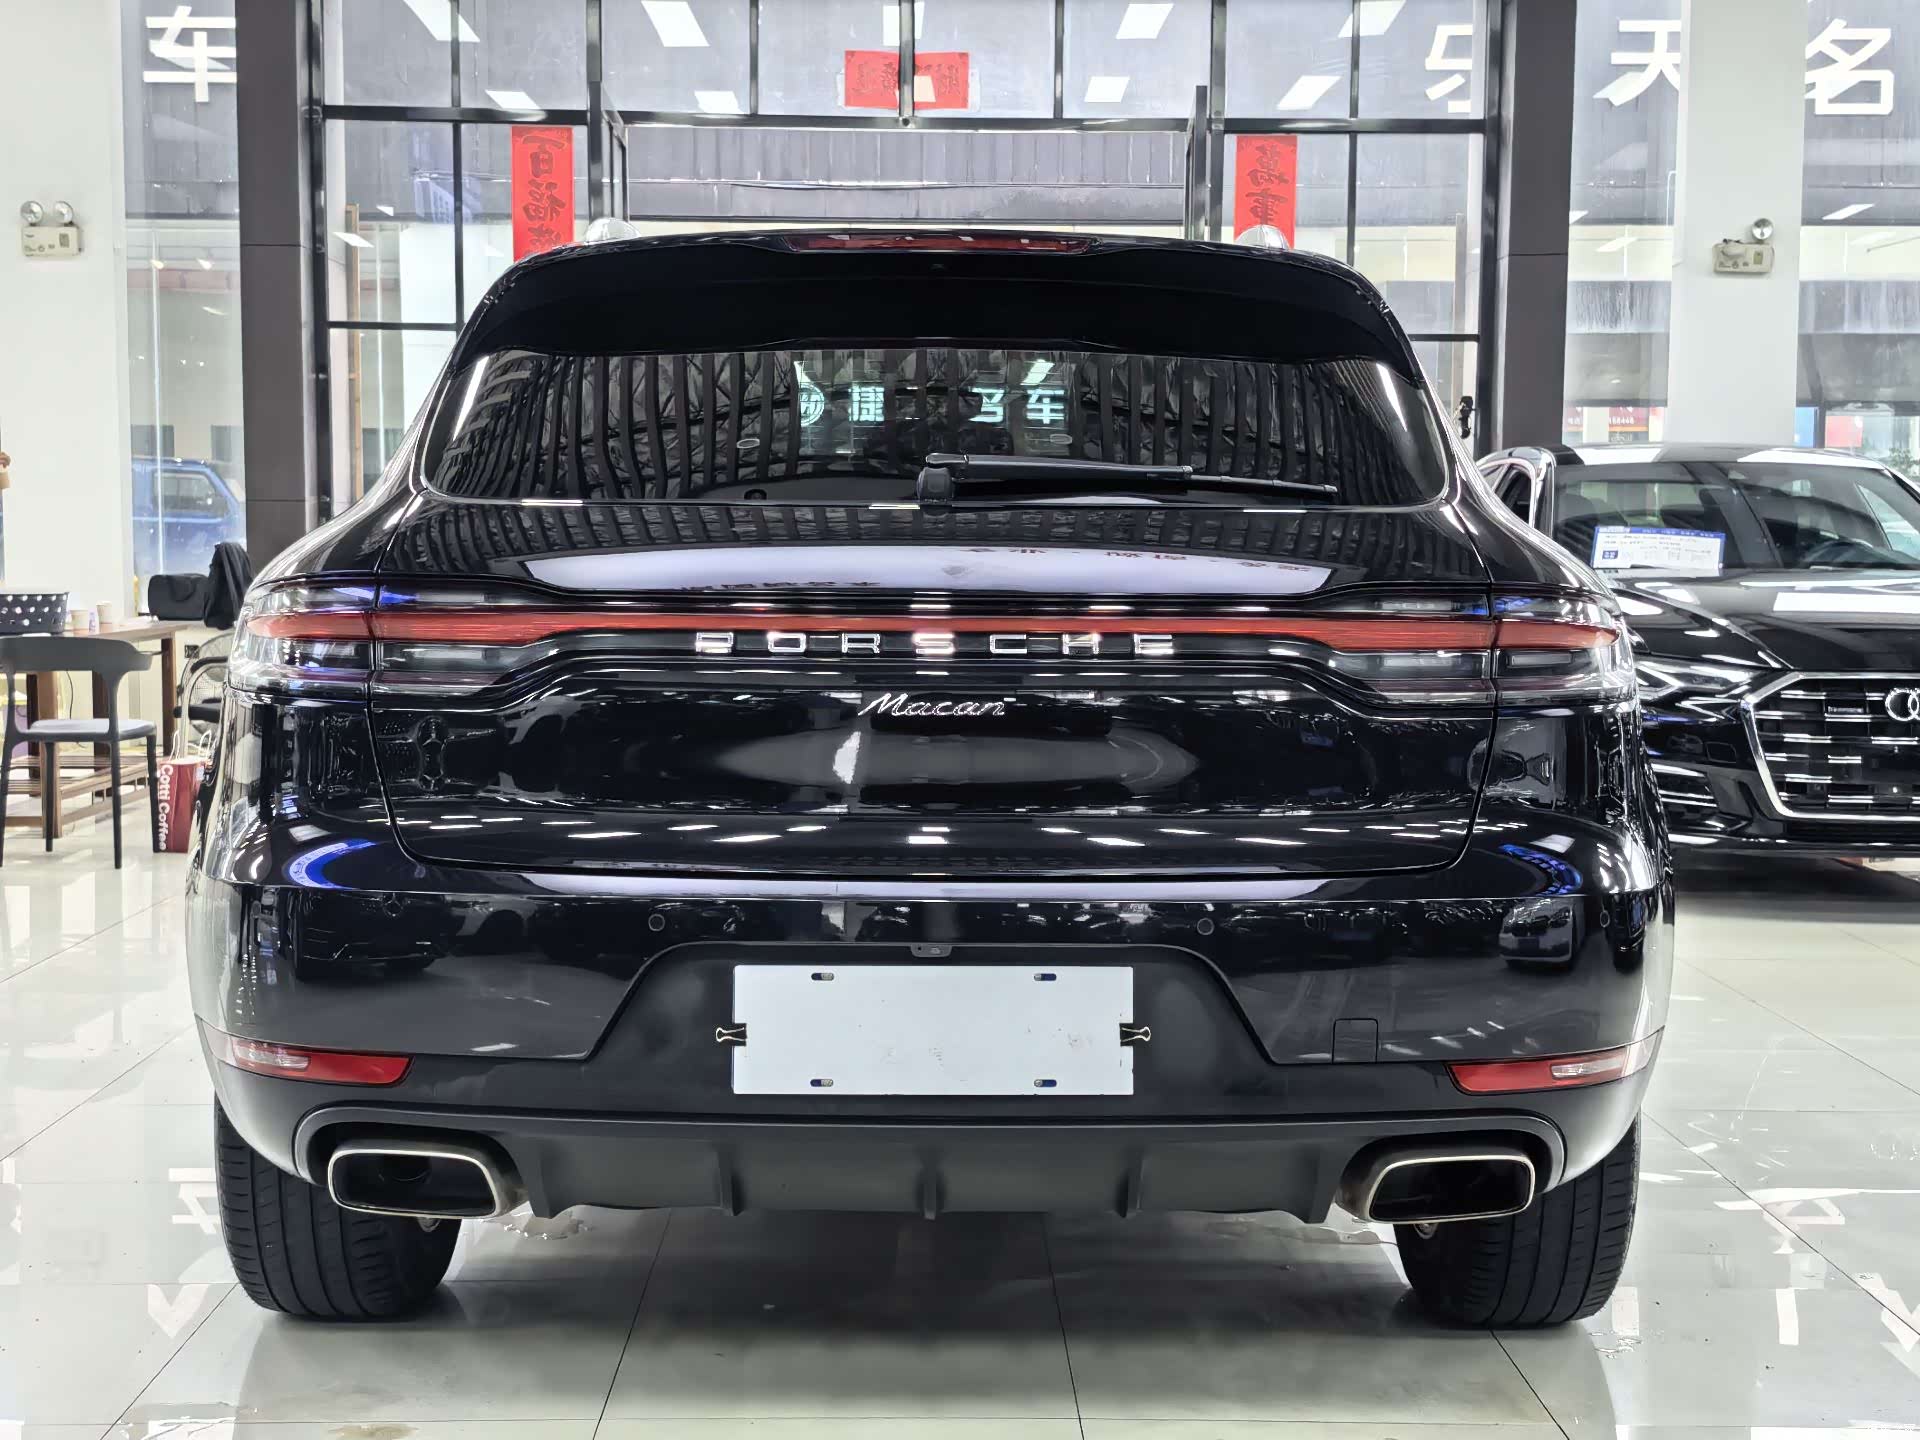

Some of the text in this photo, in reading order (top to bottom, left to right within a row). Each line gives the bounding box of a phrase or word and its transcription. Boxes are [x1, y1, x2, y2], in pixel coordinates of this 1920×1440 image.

[143, 5, 237, 102] 车
[1805, 18, 1895, 115] 名
[695, 632, 1175, 656] PORSCHE
[858, 692, 1007, 717] Macan
[158, 764, 173, 851] Cotti Coffee
